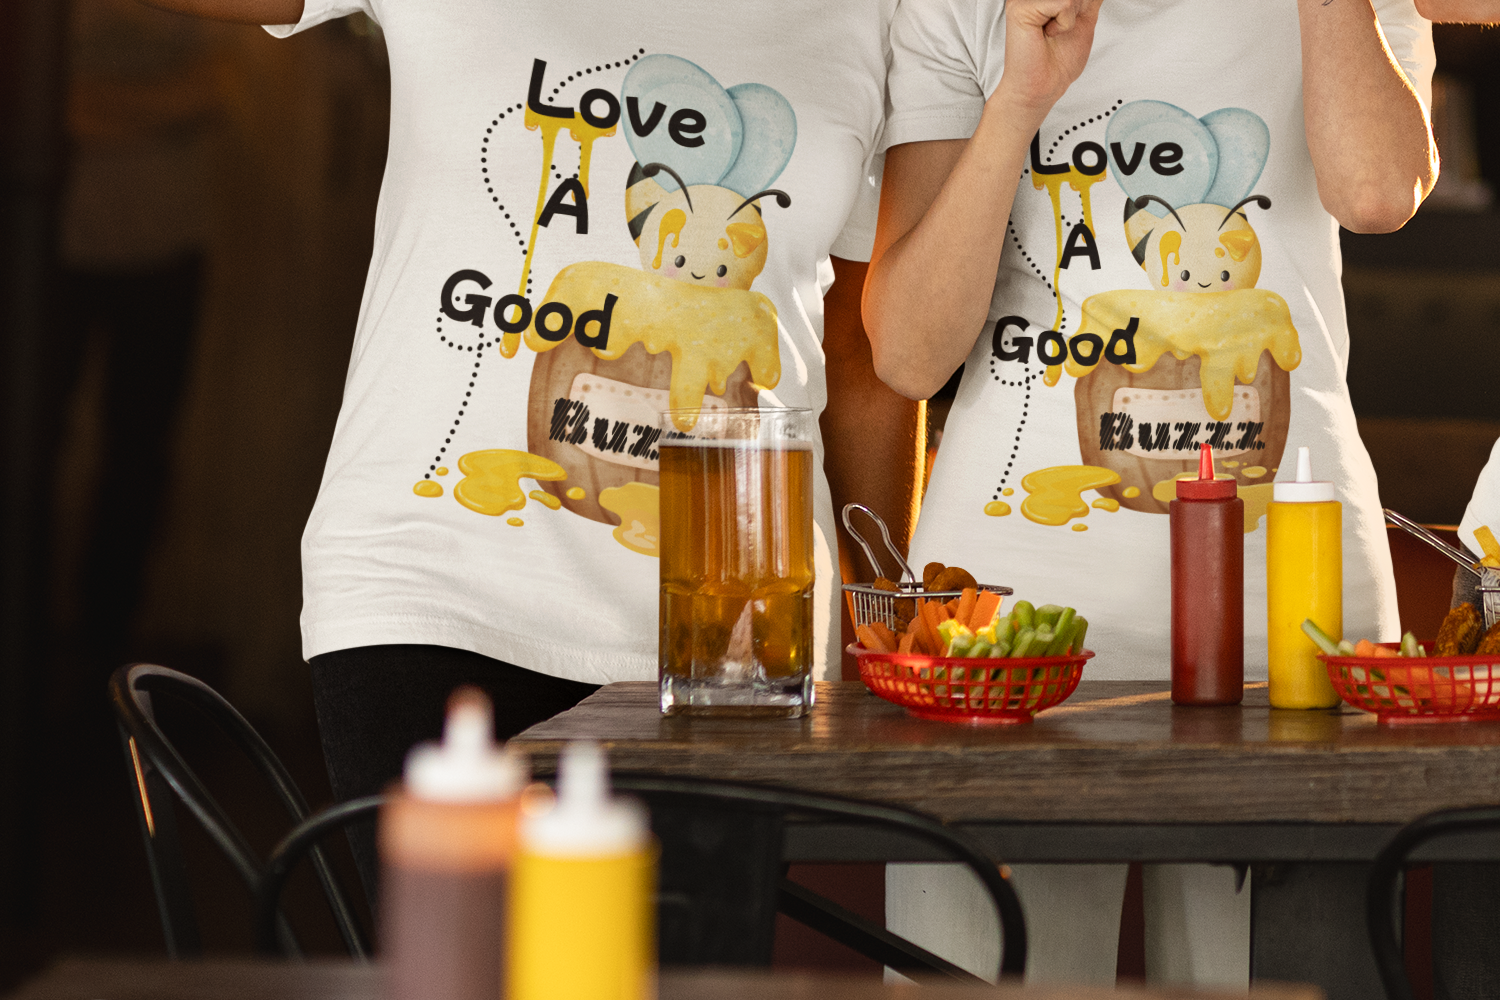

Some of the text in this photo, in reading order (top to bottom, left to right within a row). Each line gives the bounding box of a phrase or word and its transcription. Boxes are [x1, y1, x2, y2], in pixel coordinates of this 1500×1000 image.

[527, 58, 707, 148] Love
[1029, 128, 1185, 176] Love
[537, 173, 588, 235] A
[1059, 223, 1101, 270] A
[440, 269, 619, 351] Good
[992, 315, 1140, 367] Good
[549, 397, 718, 461] Buz
[1099, 412, 1266, 452] Buzzz
